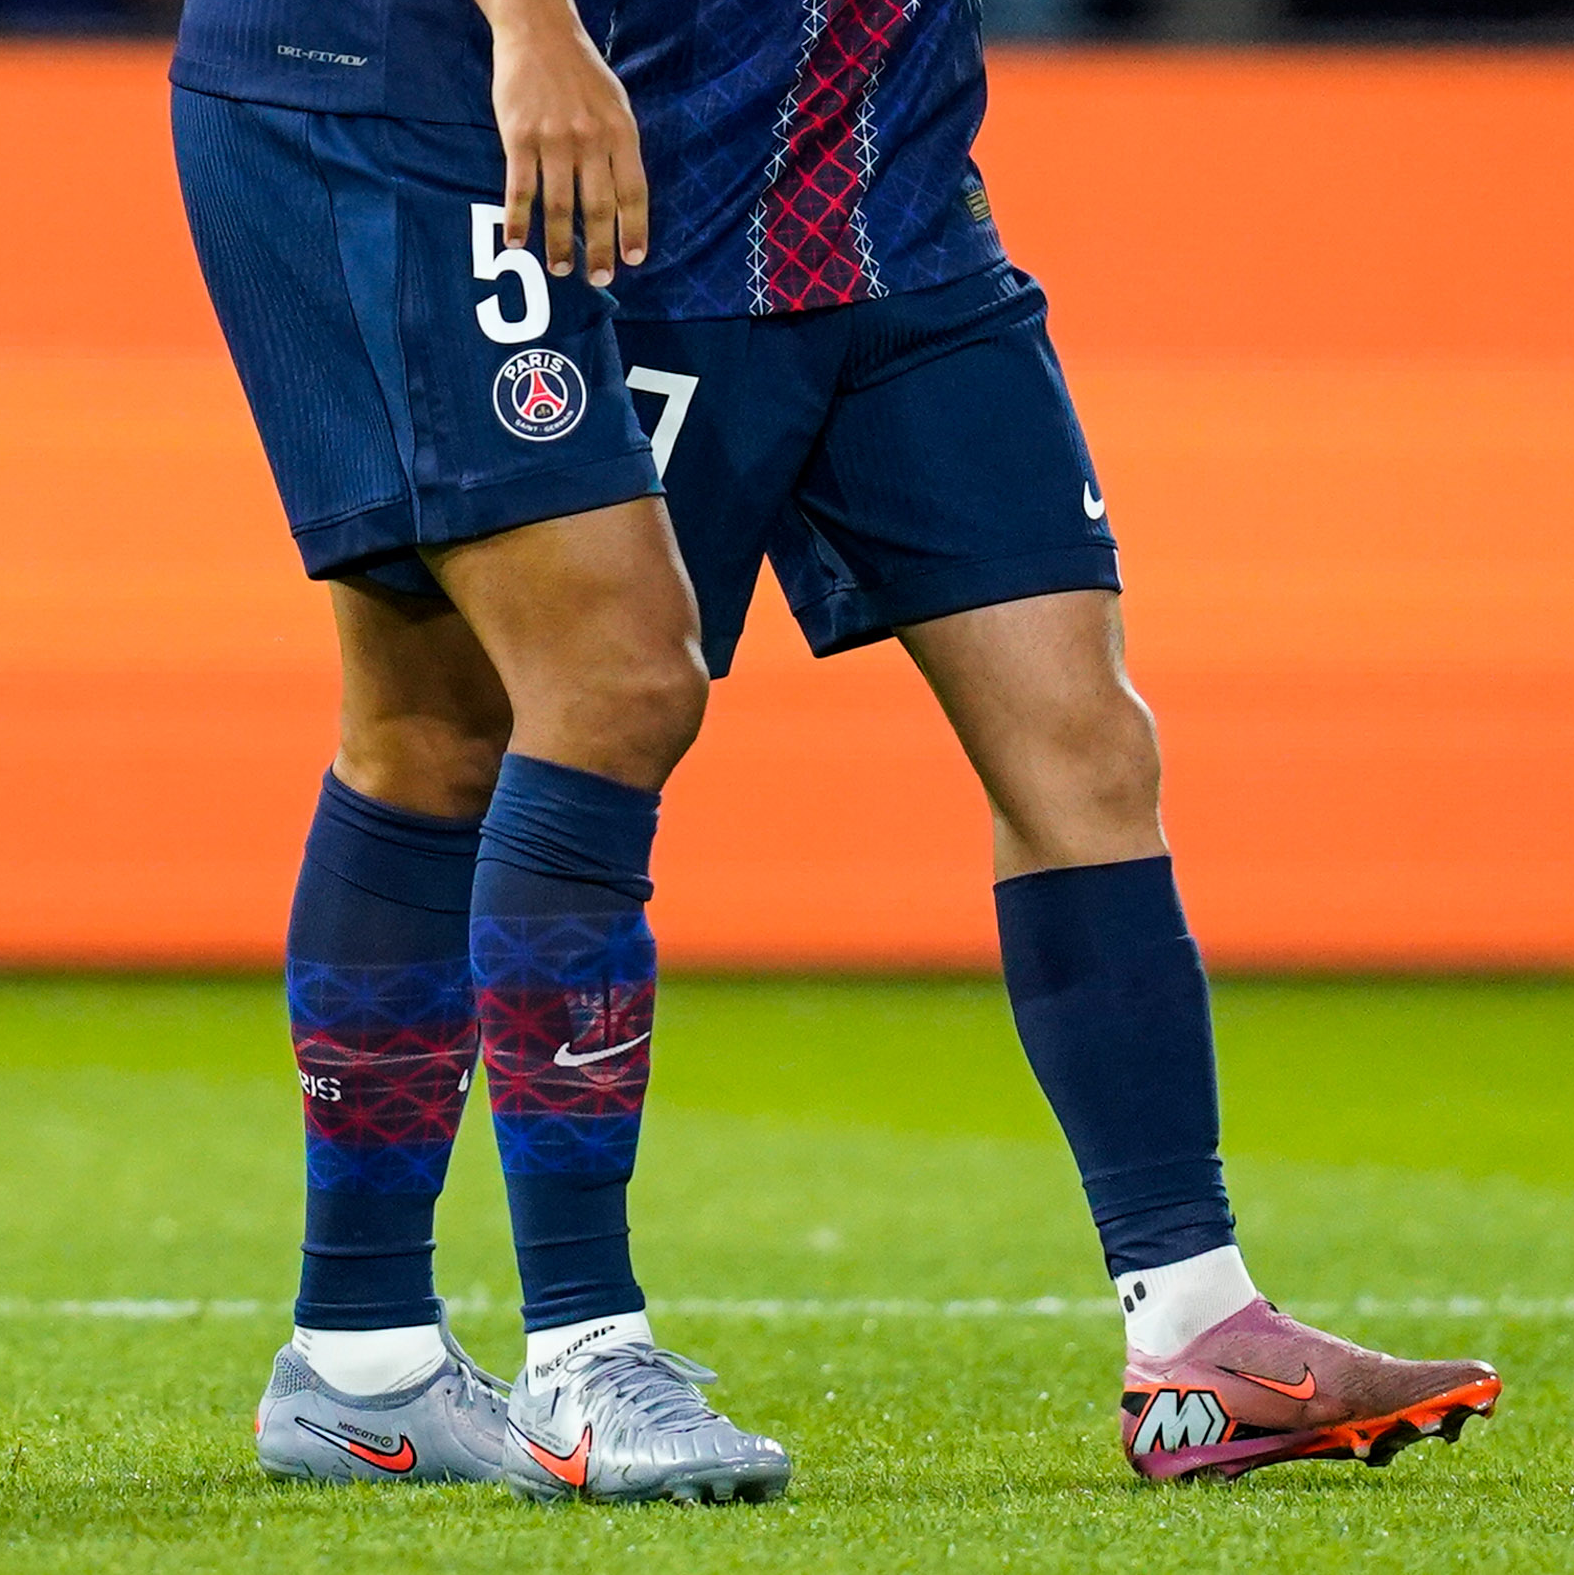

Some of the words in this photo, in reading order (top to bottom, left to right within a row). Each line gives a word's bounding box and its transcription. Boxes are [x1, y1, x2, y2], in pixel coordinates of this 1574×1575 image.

[470, 202, 552, 345] 5
[504, 352, 564, 381] PARIS
[625, 364, 700, 482] 7
